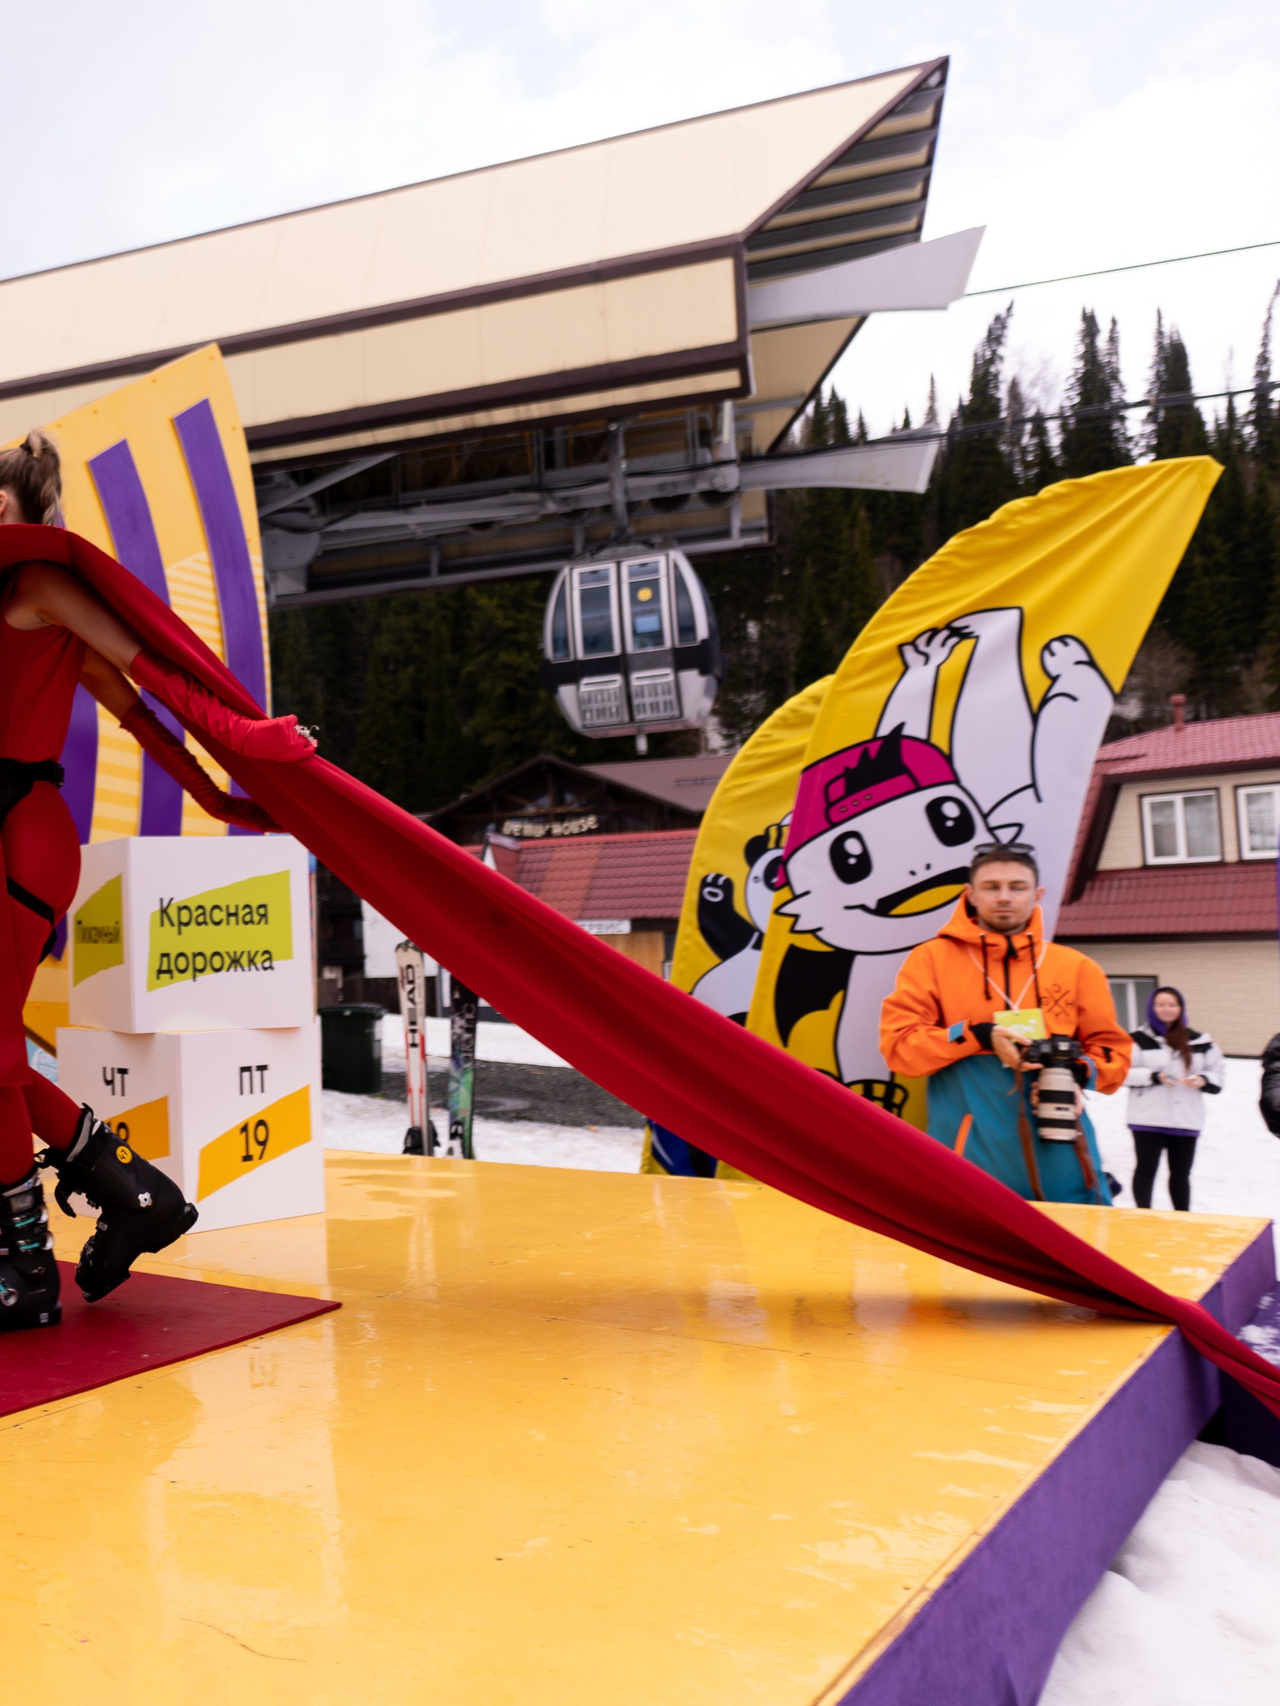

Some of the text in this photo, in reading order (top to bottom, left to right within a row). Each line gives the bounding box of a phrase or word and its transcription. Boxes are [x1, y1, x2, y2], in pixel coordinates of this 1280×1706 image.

[159, 897, 269, 936] Красная
[156, 949, 274, 982] дорожка
[405, 964, 419, 1049] HEAD
[102, 1066, 129, 1097] ЧТ
[239, 1064, 269, 1096] ПТ
[240, 1119, 269, 1162] 19
